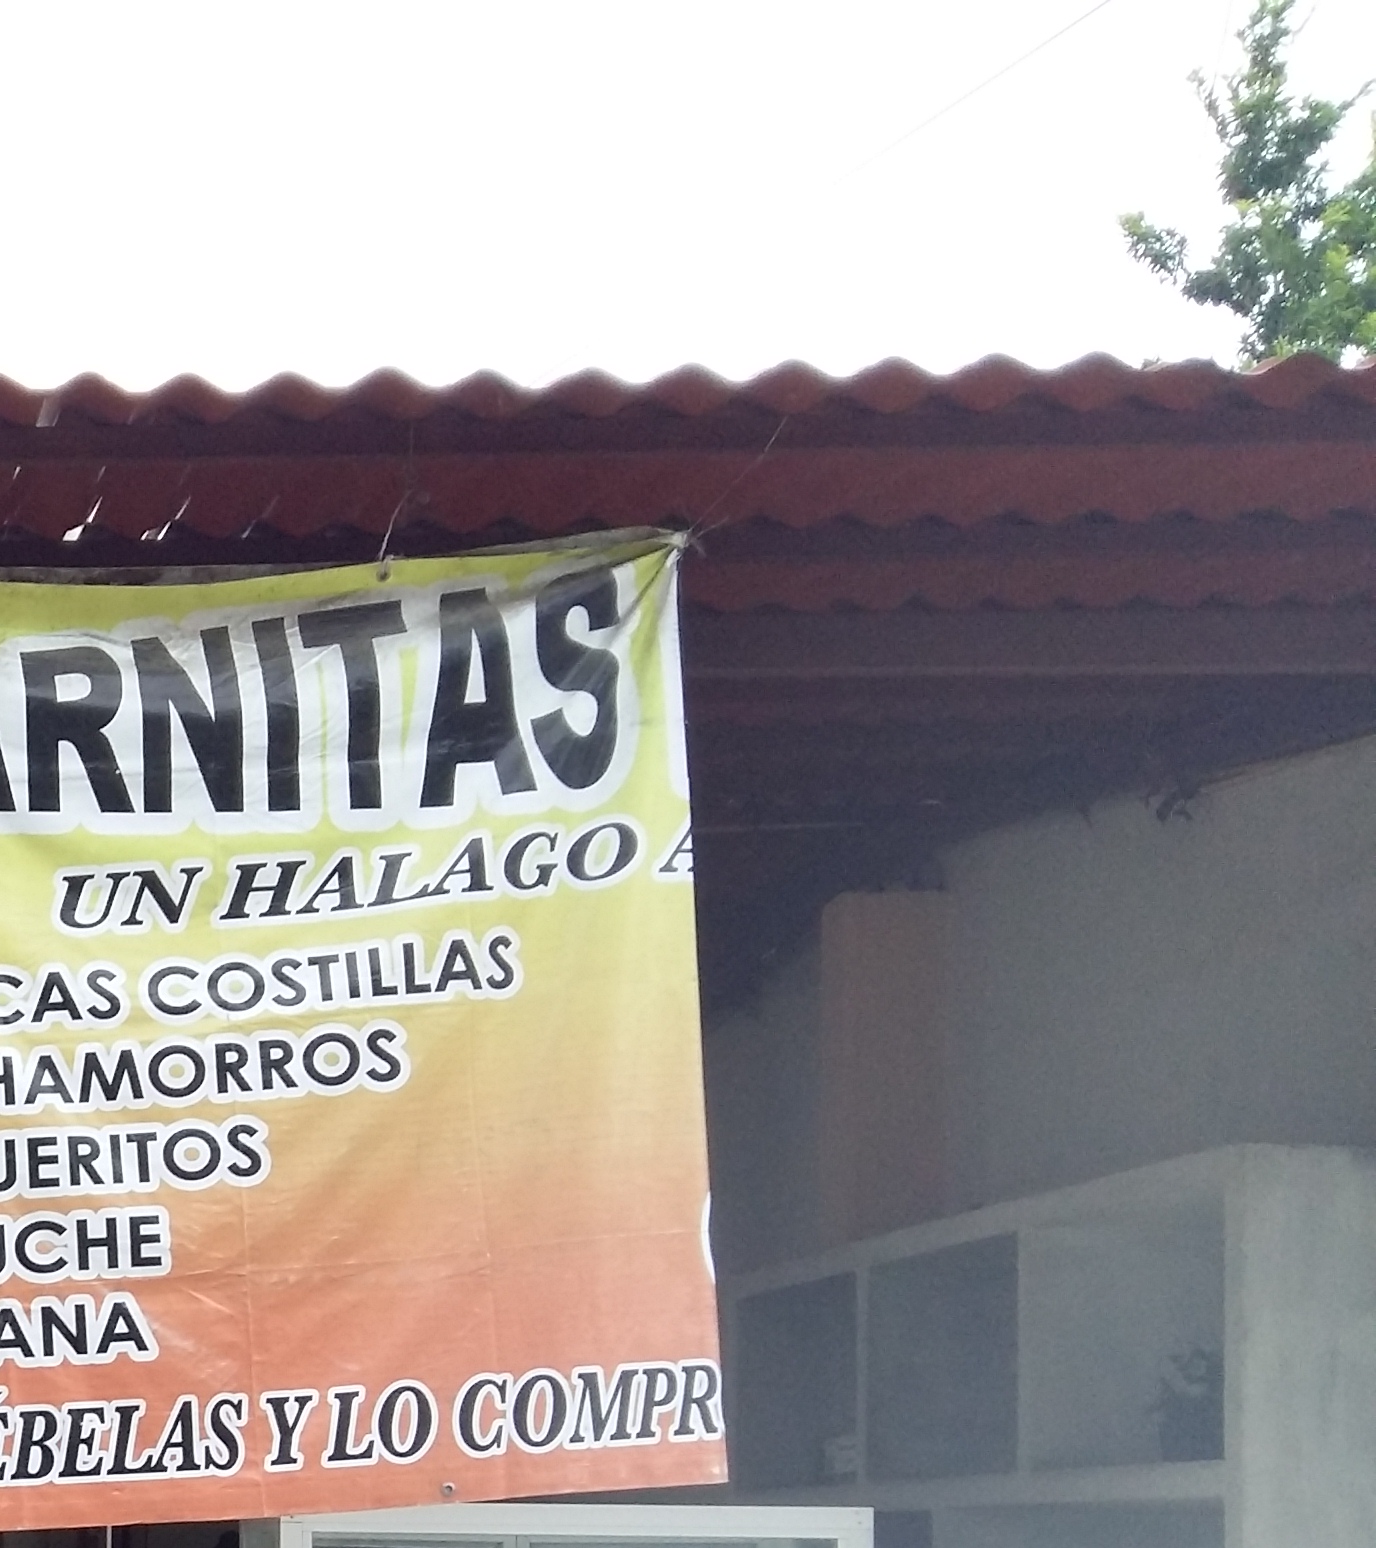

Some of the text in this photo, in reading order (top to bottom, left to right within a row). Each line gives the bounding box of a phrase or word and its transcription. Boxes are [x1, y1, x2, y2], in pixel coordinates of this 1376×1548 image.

[60, 866, 204, 929] UN
[218, 822, 639, 920] HALAGO
[148, 935, 515, 1016] COSTILLAS
[264, 1395, 313, 1467] Y
[326, 1386, 433, 1463] LO
[458, 1364, 719, 1453] COMPR
